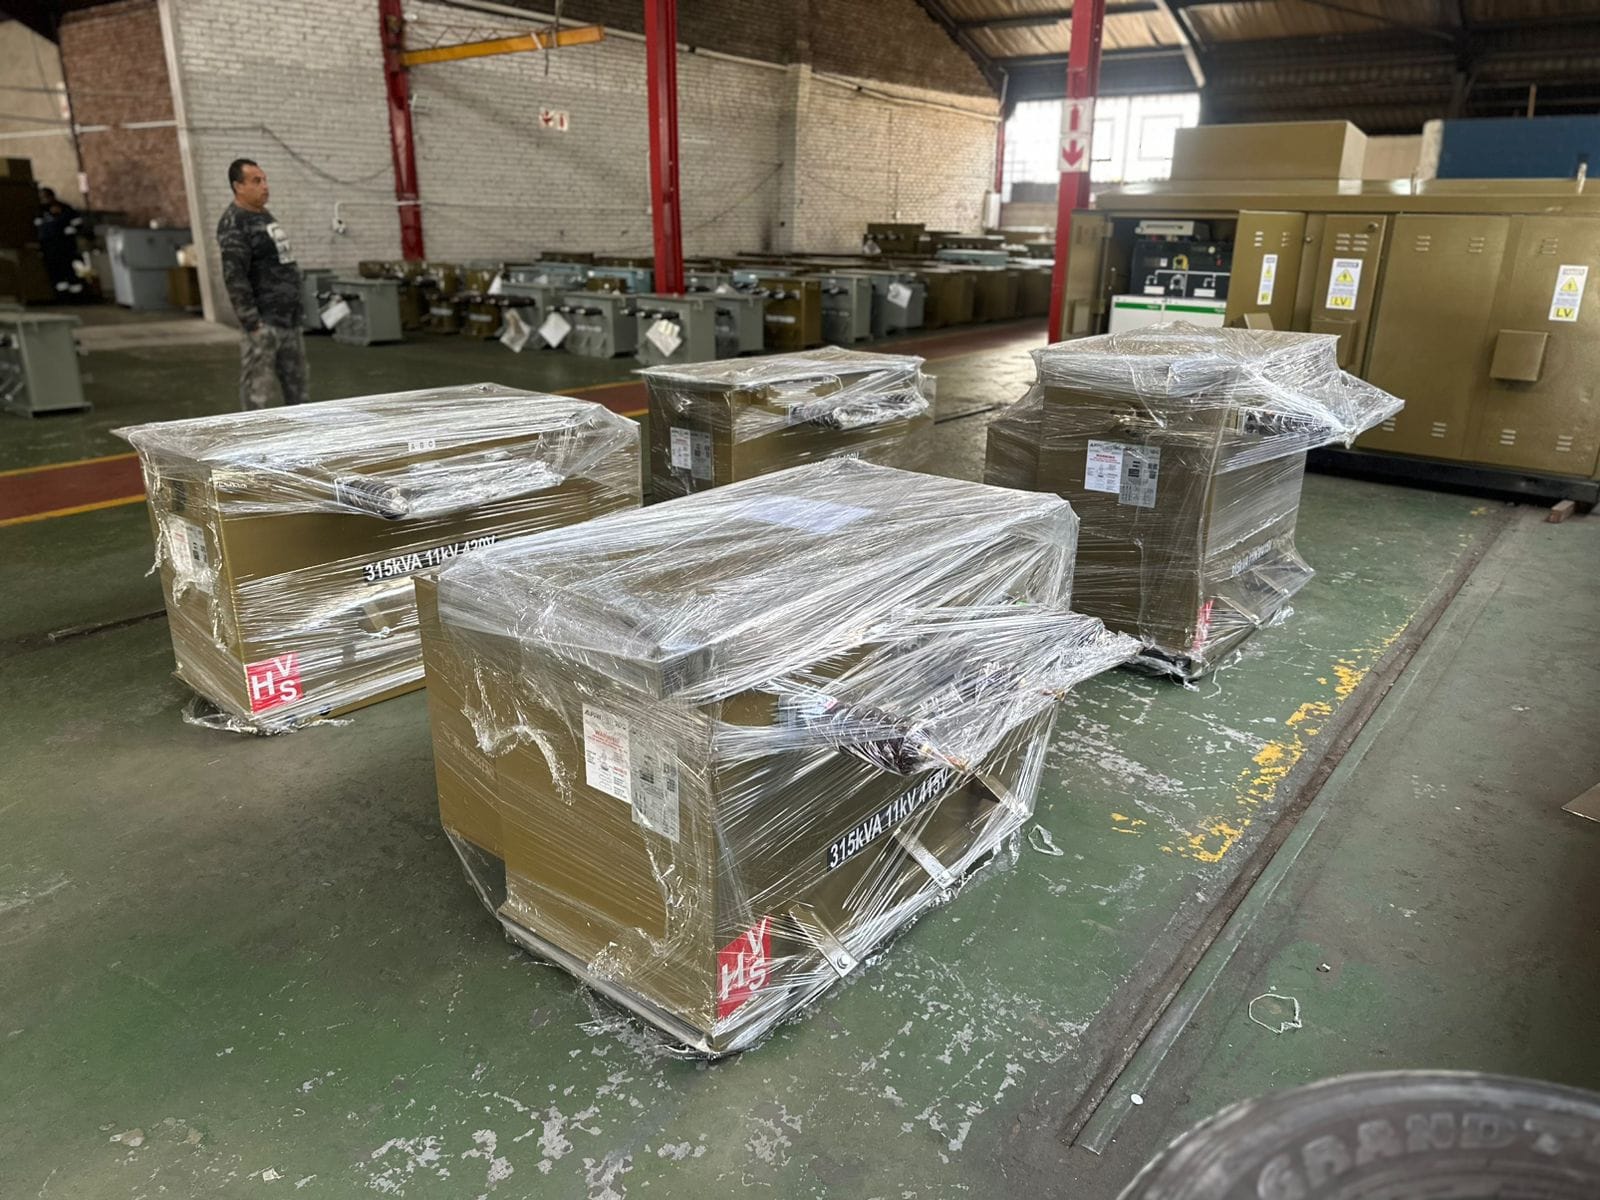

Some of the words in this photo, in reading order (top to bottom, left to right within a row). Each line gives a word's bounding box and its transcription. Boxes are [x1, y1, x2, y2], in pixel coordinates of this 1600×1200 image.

[1556, 308, 1573, 317] LV
[365, 553, 423, 581] 315kVA
[425, 543, 459, 566] 11kV
[829, 813, 883, 868] 315kVA
[885, 787, 917, 827] 11kV
